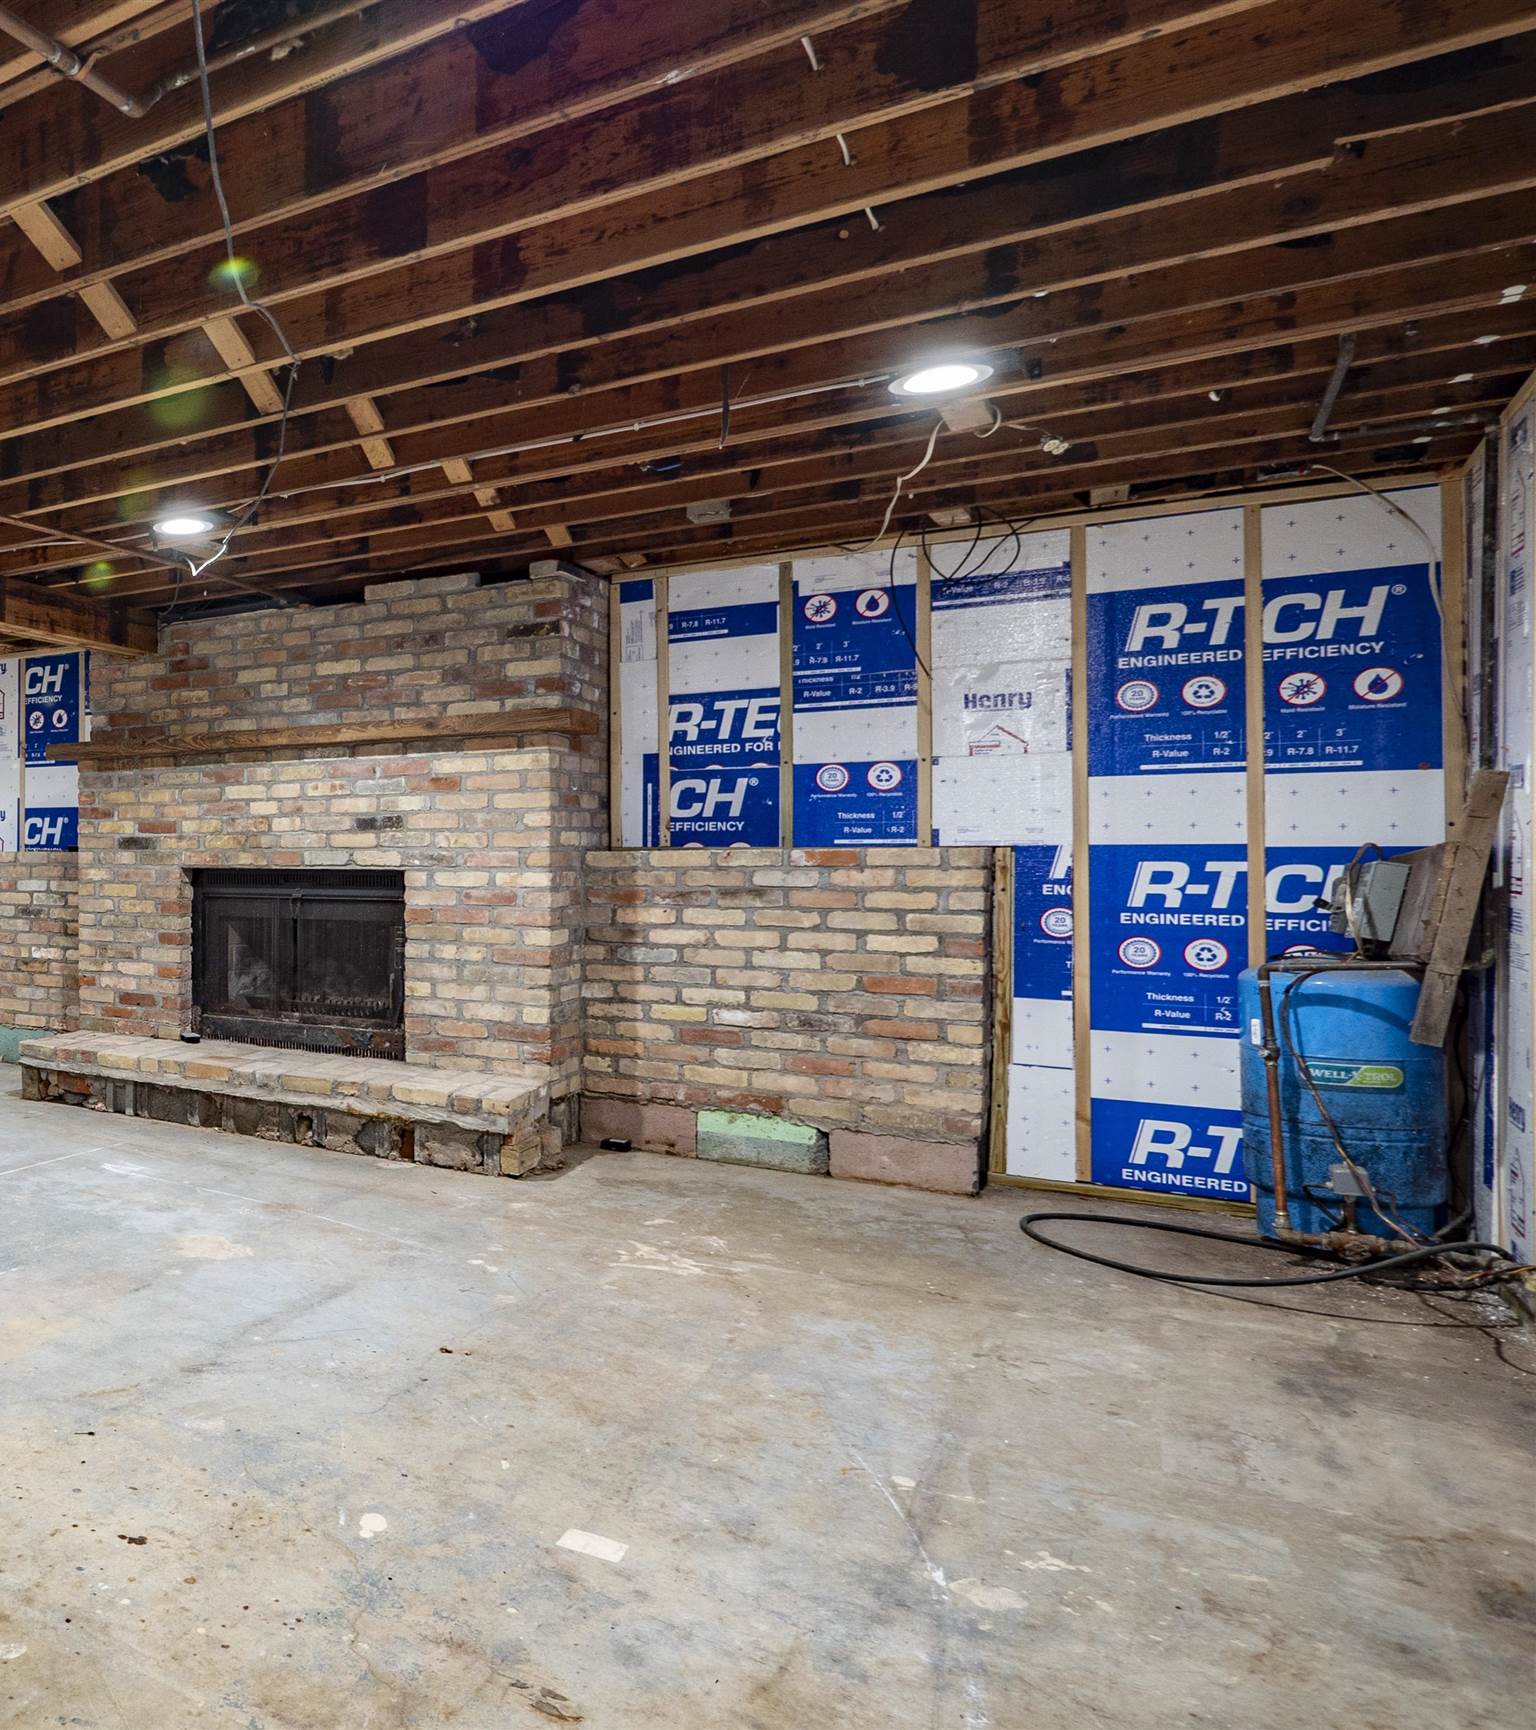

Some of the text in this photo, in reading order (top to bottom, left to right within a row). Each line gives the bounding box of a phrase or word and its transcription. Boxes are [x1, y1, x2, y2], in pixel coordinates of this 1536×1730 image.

[705, 617, 727, 626] R-11.7
[1117, 641, 1384, 669] ENGINEERED EFFICIENCY
[25, 695, 63, 705] EFFICIENCY
[803, 690, 832, 698] R-Value
[964, 692, 1032, 710] Henry
[669, 696, 780, 741] R-TE
[1144, 734, 1192, 742] Thickness
[669, 741, 773, 756] NGINEERED FOR
[1152, 745, 1359, 758] R-Value R-2 R-7.8 R-11.7
[669, 821, 744, 832] EFFICIENCY
[1120, 912, 1331, 932] ENGINEERED EFFICI
[1146, 992, 1194, 1002] Thickness
[1154, 1009, 1232, 1020] R-Value R-2
[1121, 1168, 1248, 1194] ENGINEERED
